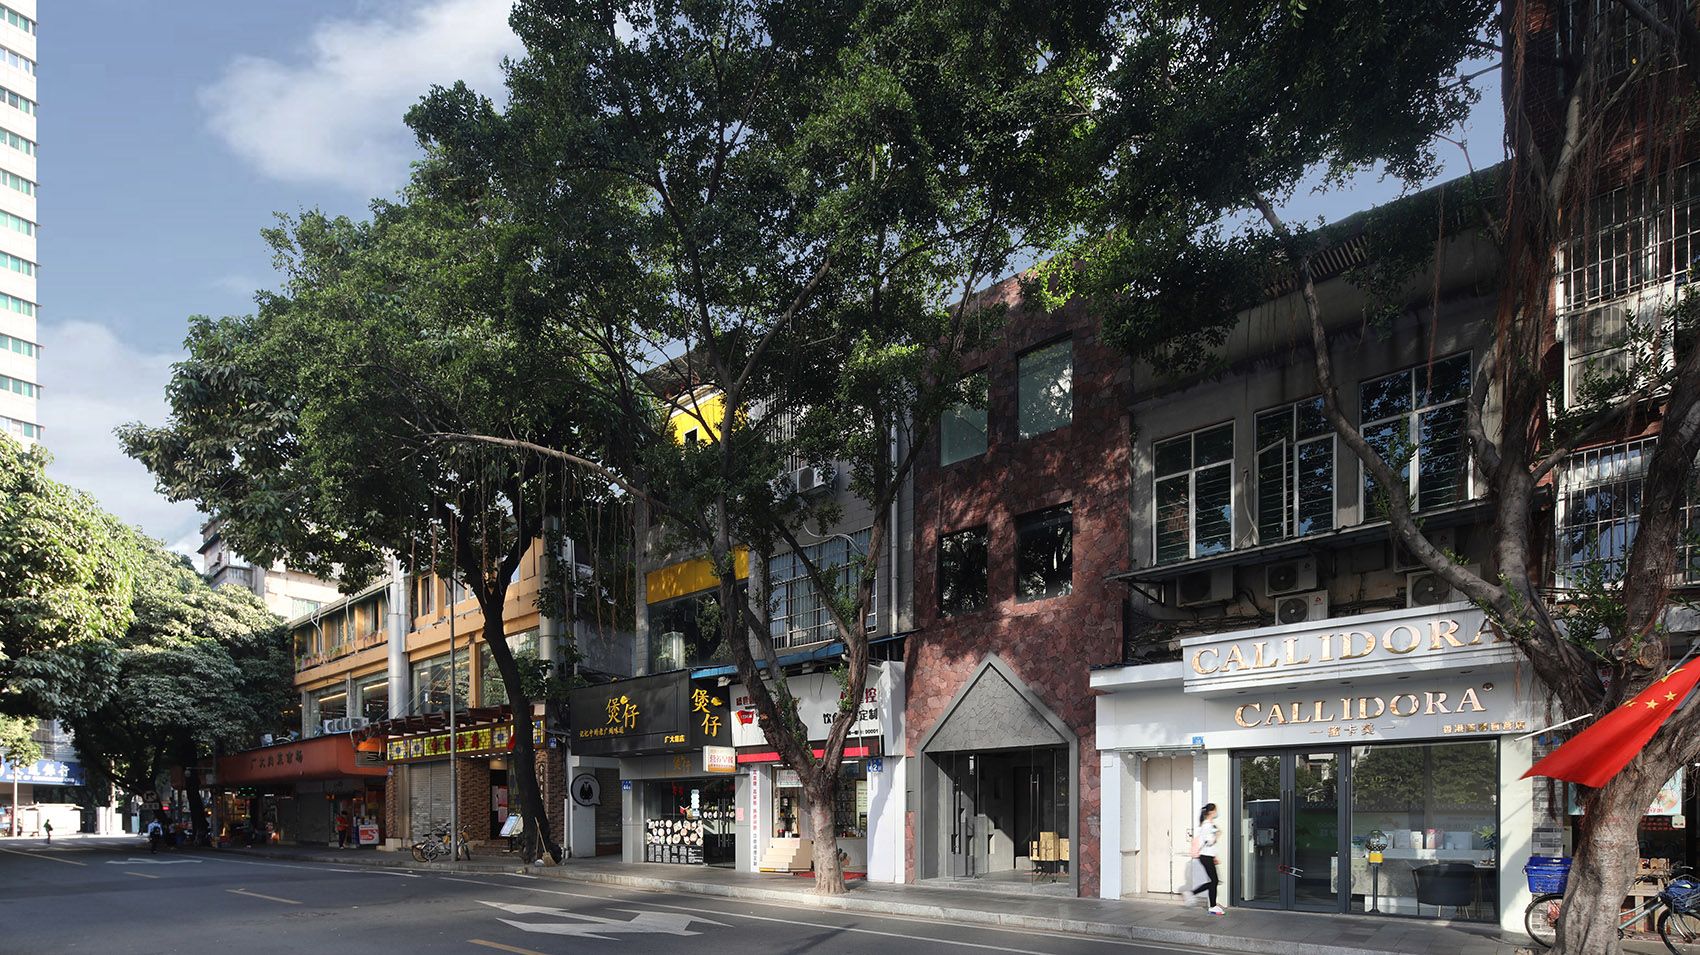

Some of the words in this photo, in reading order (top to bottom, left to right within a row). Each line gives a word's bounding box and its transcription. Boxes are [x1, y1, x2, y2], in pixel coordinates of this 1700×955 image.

[1192, 617, 1510, 674] CALLIDORA
[606, 697, 640, 729] 煲仔
[691, 688, 722, 737] 煲仔
[1235, 687, 1487, 727] CALLIDORA
